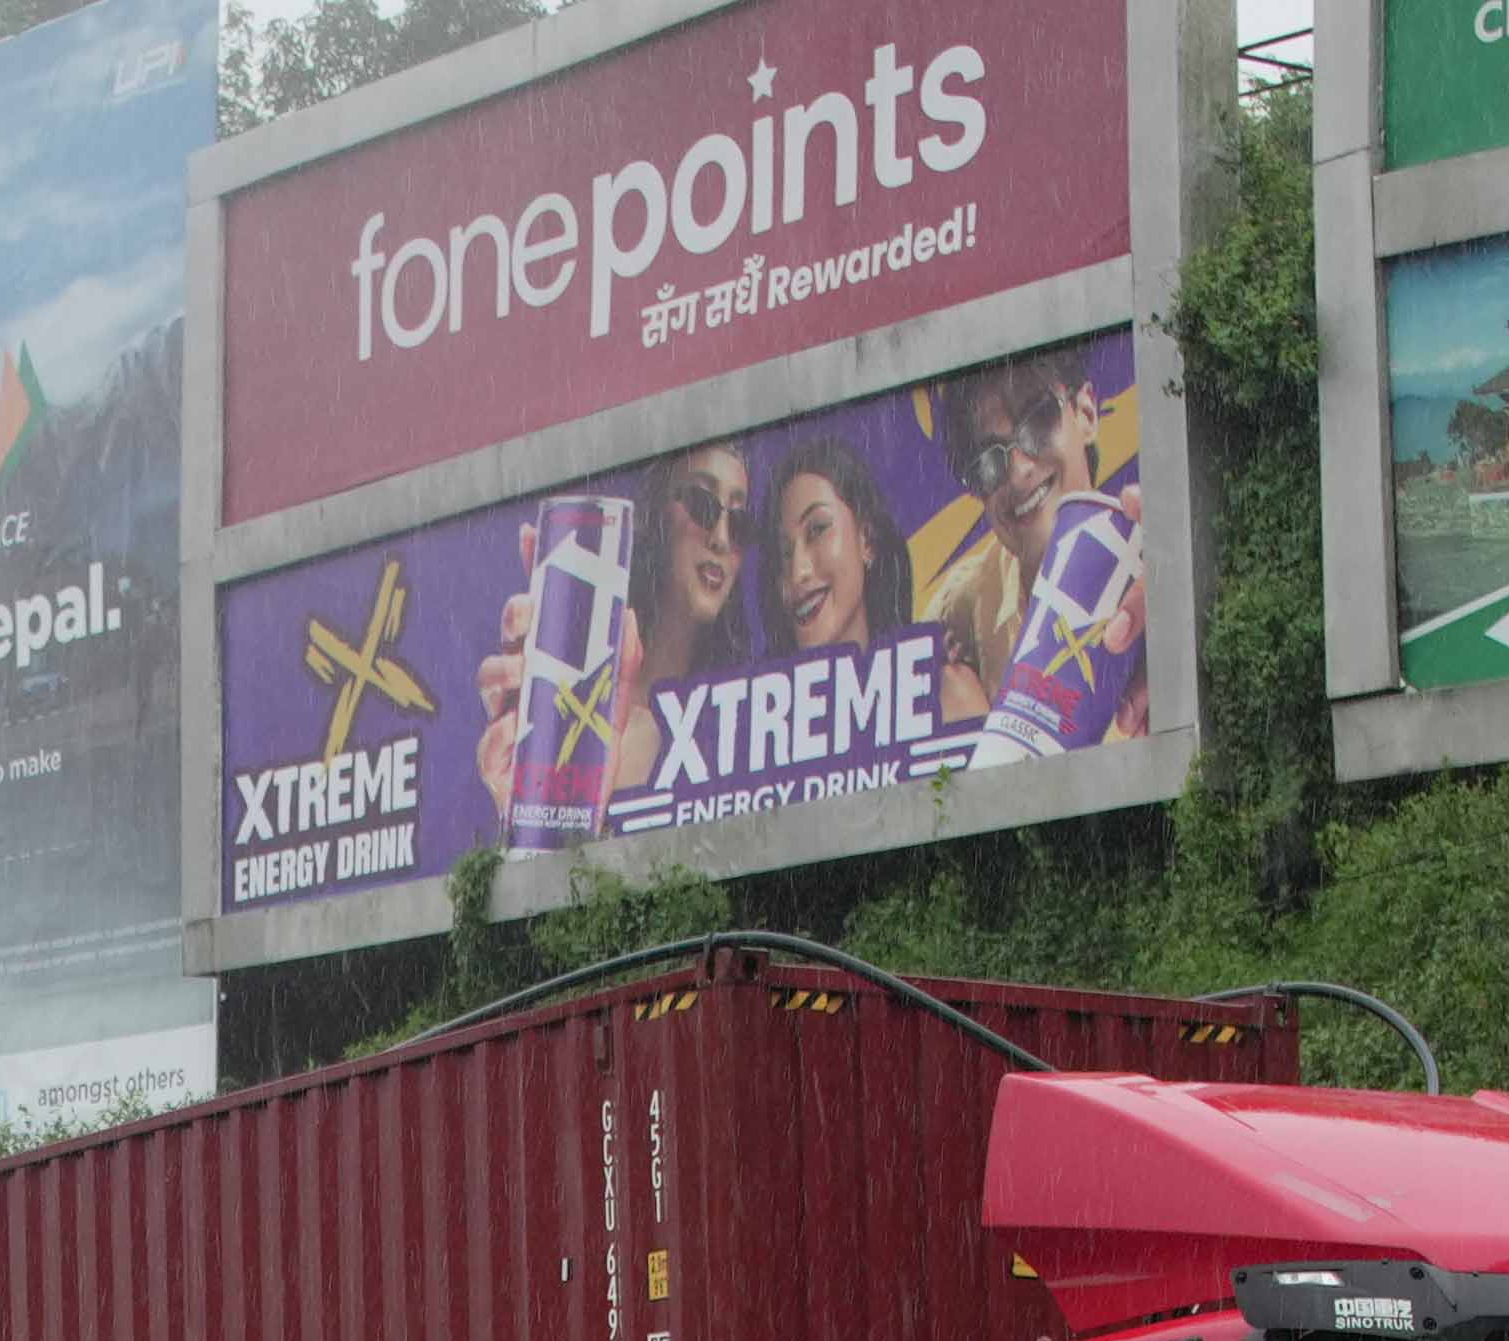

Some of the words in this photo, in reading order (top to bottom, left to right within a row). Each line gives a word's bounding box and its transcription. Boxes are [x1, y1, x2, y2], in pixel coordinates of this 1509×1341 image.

[767, 202, 977, 309] Rewarded!
[9, 749, 63, 781] make
[653, 635, 935, 791] XTREME
[235, 736, 419, 845] XTREME
[235, 841, 330, 903] ENERGY
[336, 822, 415, 881] DRINK
[38, 1075, 120, 1108] amongst
[125, 1067, 186, 1094] others
[601, 1099, 617, 1232] GCXU
[649, 1089, 664, 1224] 45G1
[1334, 1317, 1415, 1332] SINOTRUK
